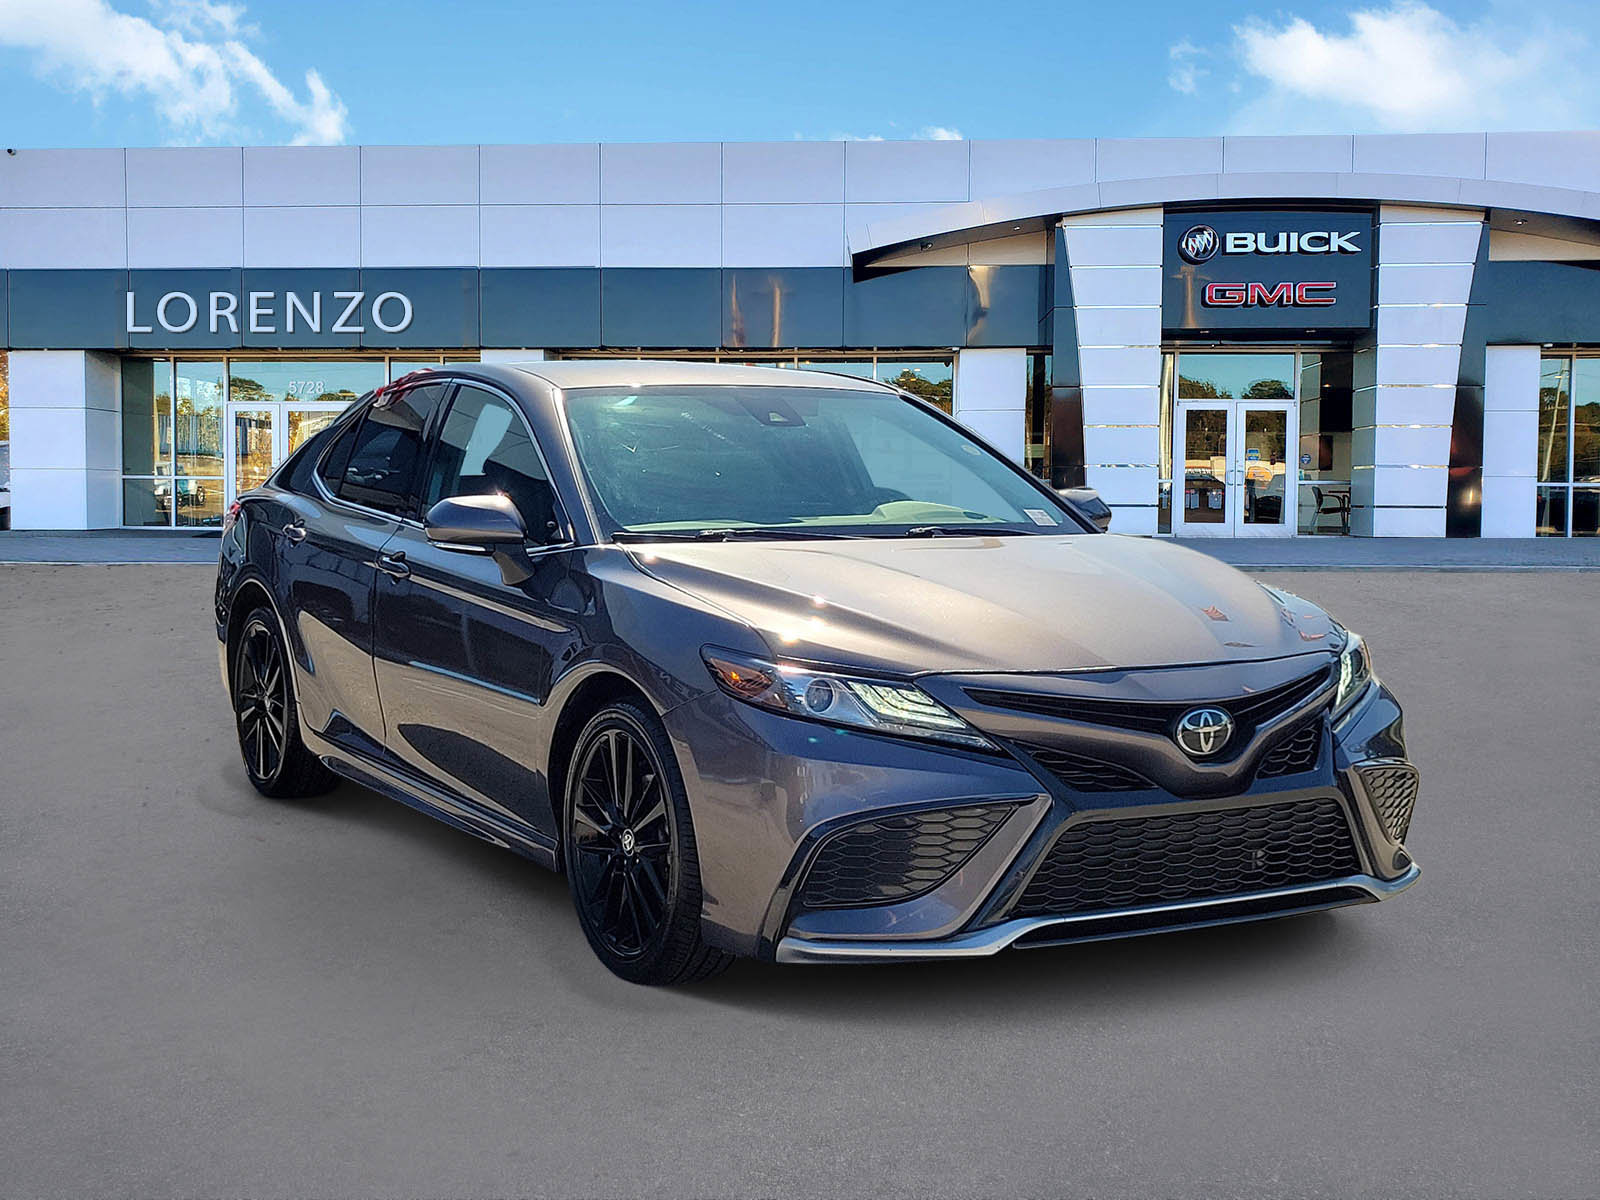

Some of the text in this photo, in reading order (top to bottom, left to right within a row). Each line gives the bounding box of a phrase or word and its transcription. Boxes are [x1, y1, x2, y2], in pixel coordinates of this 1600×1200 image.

[1225, 231, 1362, 253] BUICK
[1205, 281, 1337, 305] GMC
[126, 291, 414, 334] LORENZO
[288, 380, 325, 394] 5728
